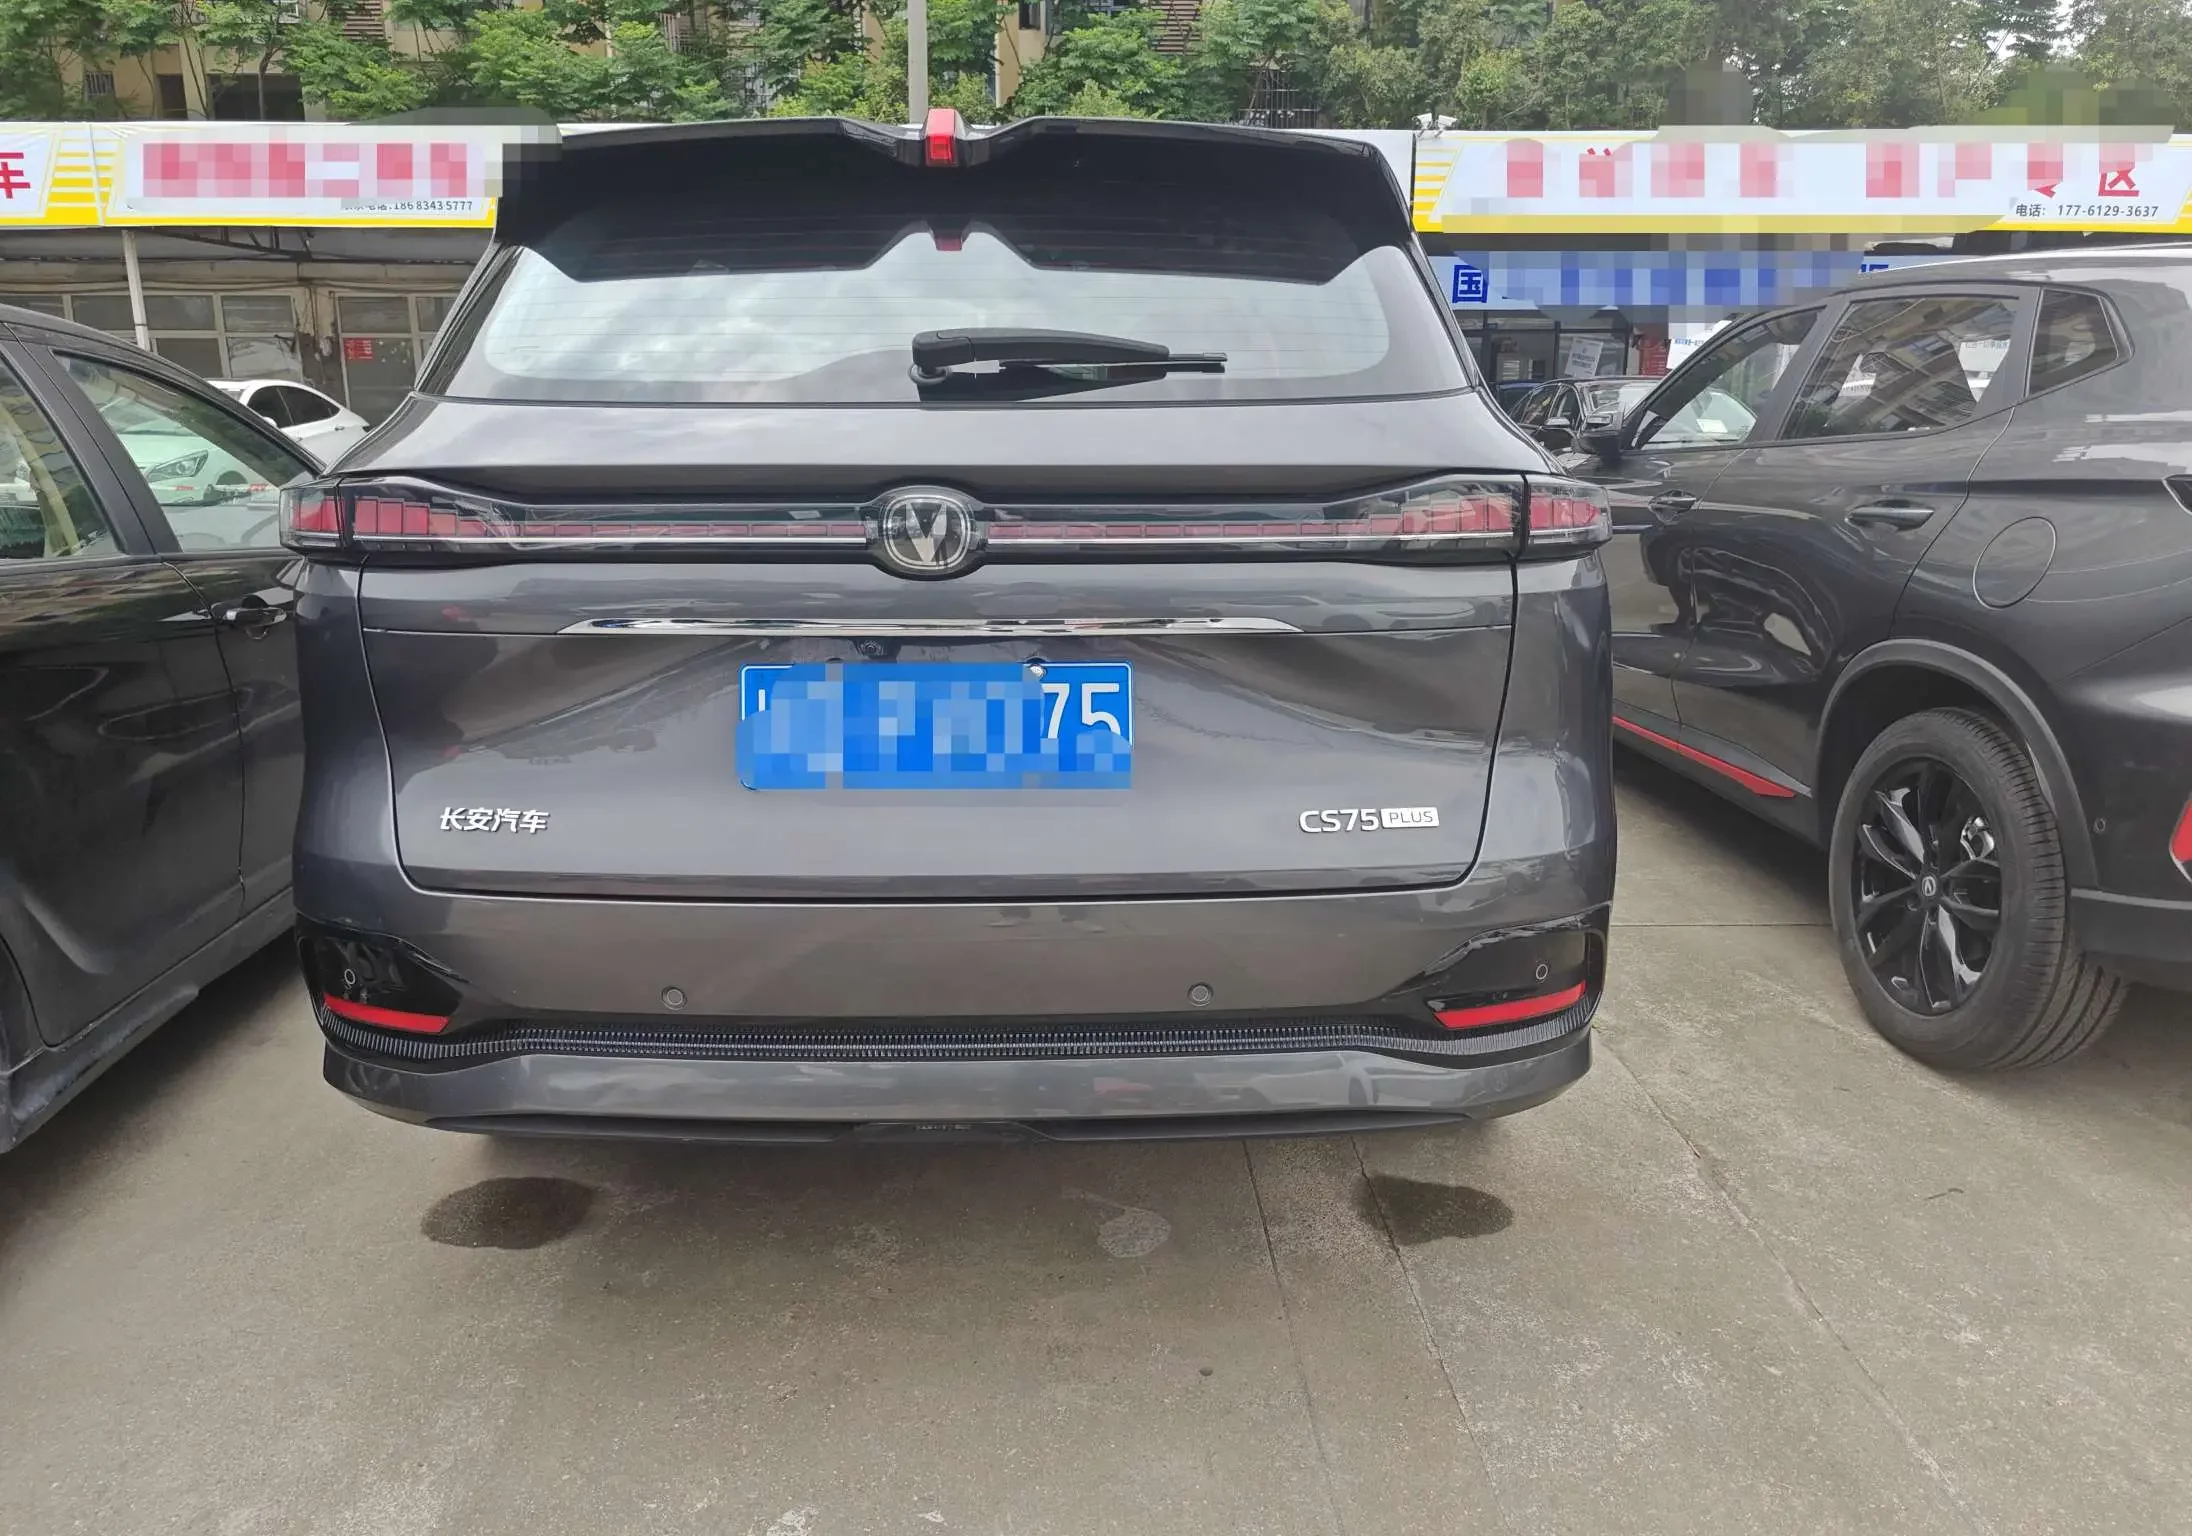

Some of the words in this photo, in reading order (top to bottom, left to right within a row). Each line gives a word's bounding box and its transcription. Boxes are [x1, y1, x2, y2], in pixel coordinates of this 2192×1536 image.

[2058, 204, 2160, 218] 177-6129-3637
[440, 806, 550, 833] 长安汽车
[1299, 808, 1379, 833] CS75
[1389, 810, 1433, 824] PLUS
